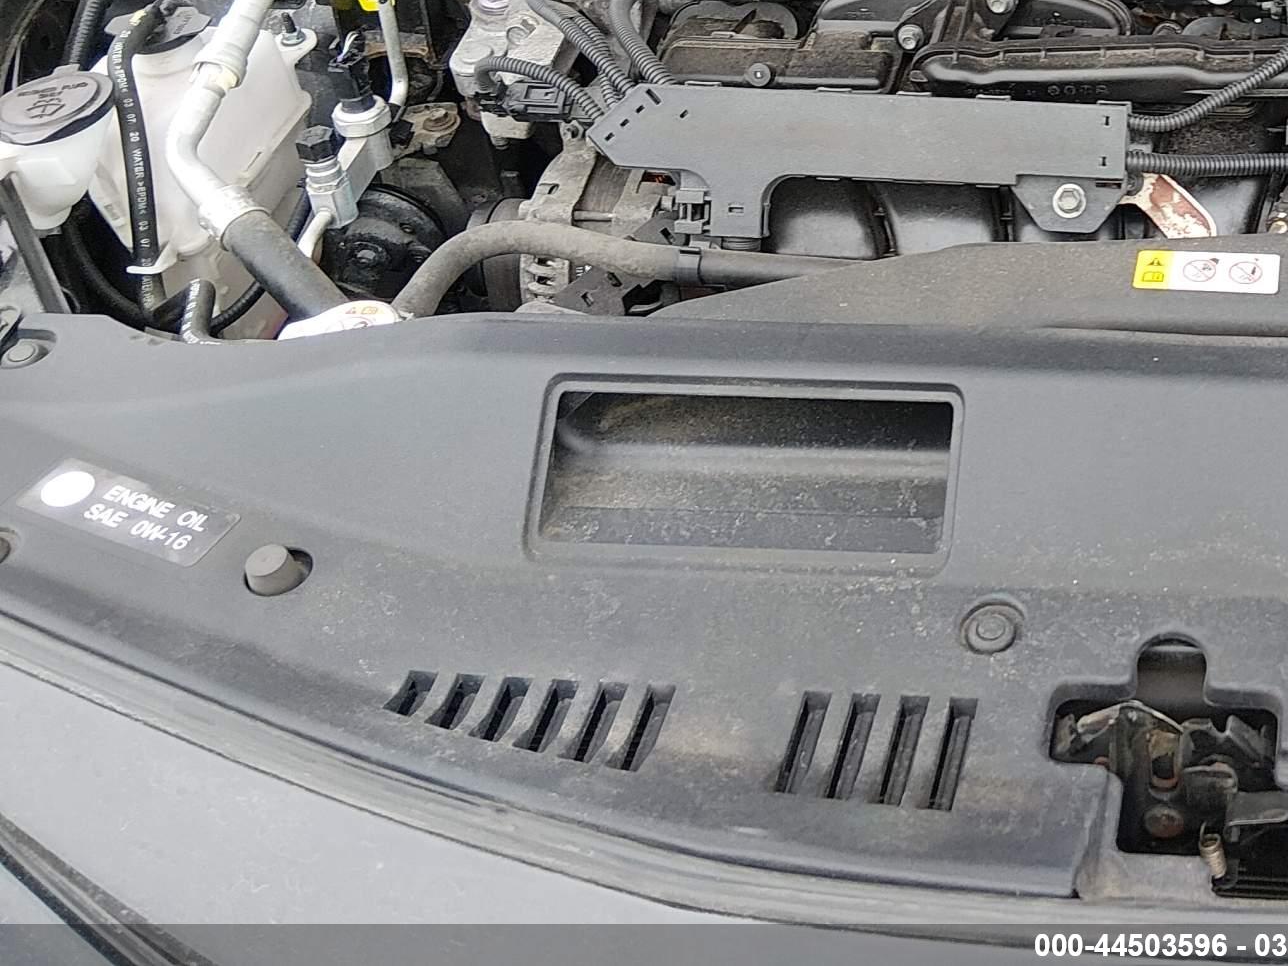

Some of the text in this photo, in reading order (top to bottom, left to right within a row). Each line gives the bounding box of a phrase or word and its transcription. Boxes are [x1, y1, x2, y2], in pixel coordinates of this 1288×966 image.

[112, 41, 124, 66] WATER
[123, 98, 135, 108] 03
[127, 113, 137, 123] 07
[129, 131, 140, 143] 20
[132, 147, 145, 180] WATER
[138, 220, 149, 231] 03
[140, 238, 150, 248] 07
[102, 485, 209, 532] ENGINE OIL
[84, 503, 193, 551] SAE 0W-16
